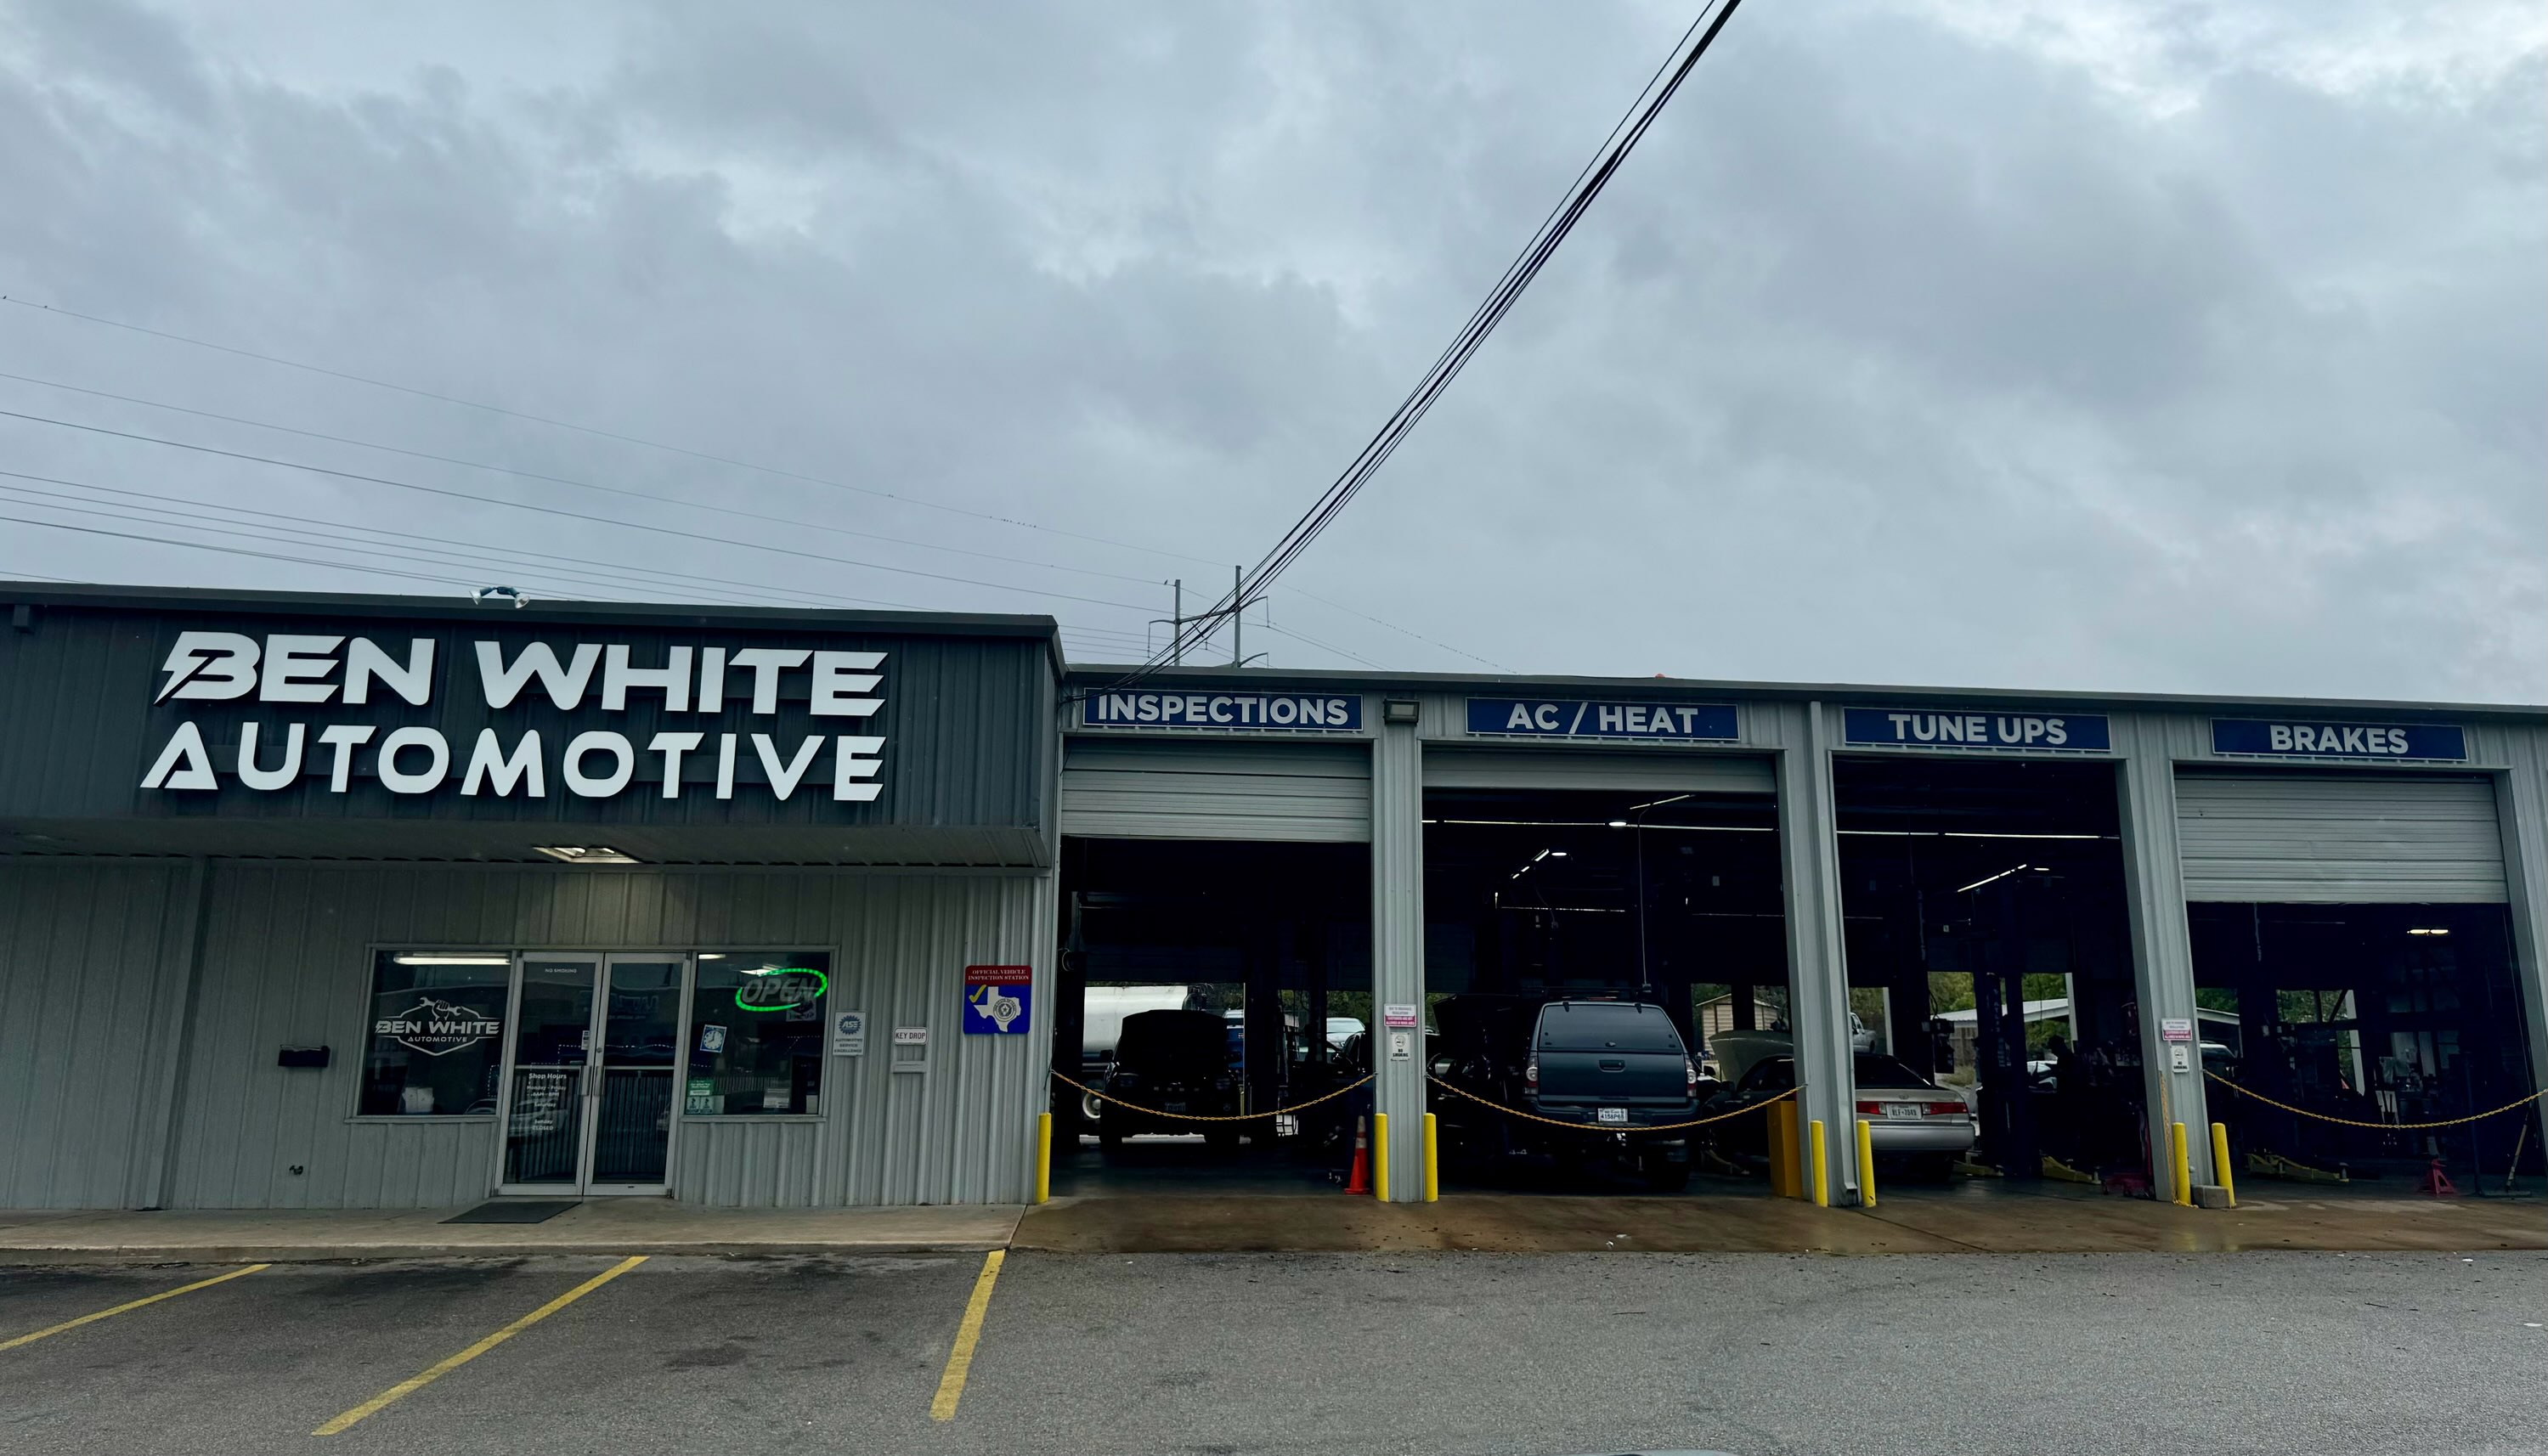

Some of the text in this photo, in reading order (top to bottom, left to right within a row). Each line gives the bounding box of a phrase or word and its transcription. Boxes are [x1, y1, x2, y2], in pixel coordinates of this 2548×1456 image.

[155, 632, 888, 715] BEN WHITE
[1098, 695, 1348, 725] INSPECTIONS
[1506, 702, 1698, 734] AC / HEAT
[1889, 714, 2067, 745] TUNE UPS
[2271, 726, 2410, 754] BRAKES
[140, 722, 886, 800] AUTOMOTIVE
[742, 978, 818, 1003] OPEN
[375, 1020, 500, 1034] BEN WHITE
